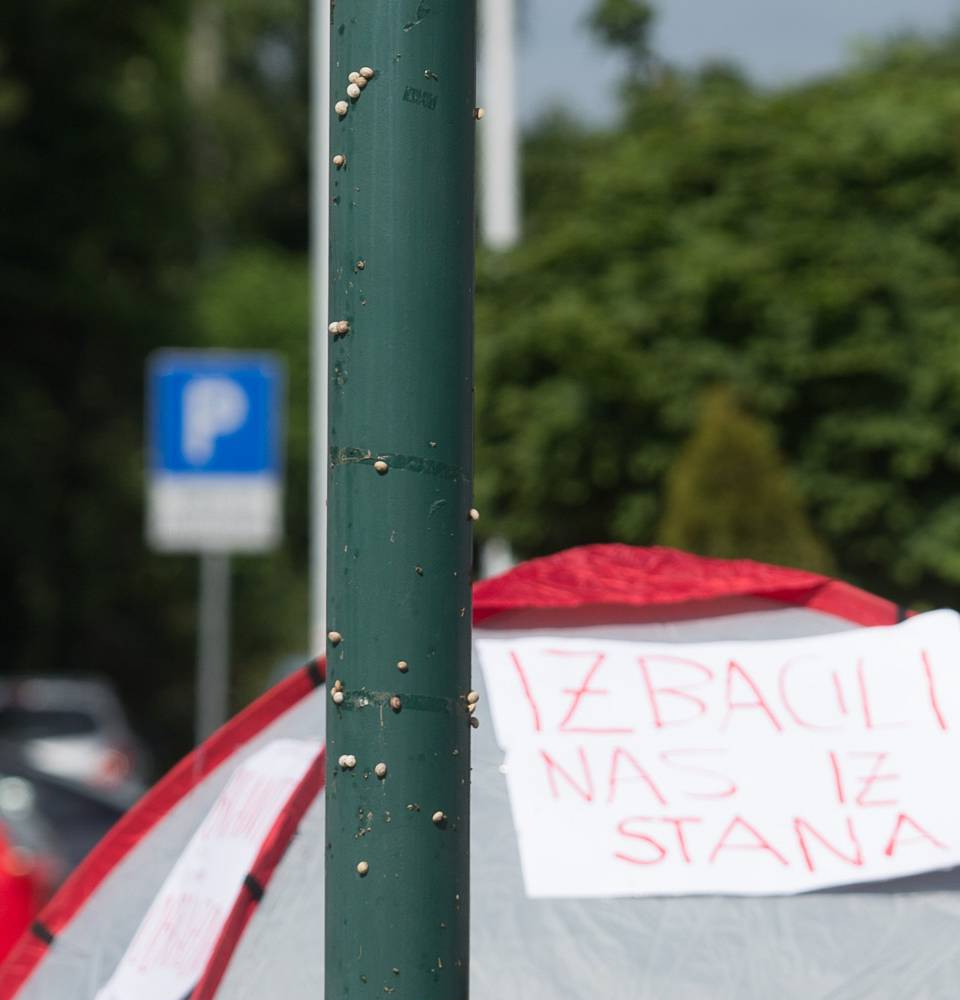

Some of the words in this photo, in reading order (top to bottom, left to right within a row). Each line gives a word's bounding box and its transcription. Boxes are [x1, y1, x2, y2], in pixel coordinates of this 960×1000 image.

[181, 376, 250, 467] P
[508, 648, 948, 733] IZBACILI
[538, 745, 737, 805] NAS
[829, 750, 900, 808] IZ
[613, 812, 950, 872] STANA
